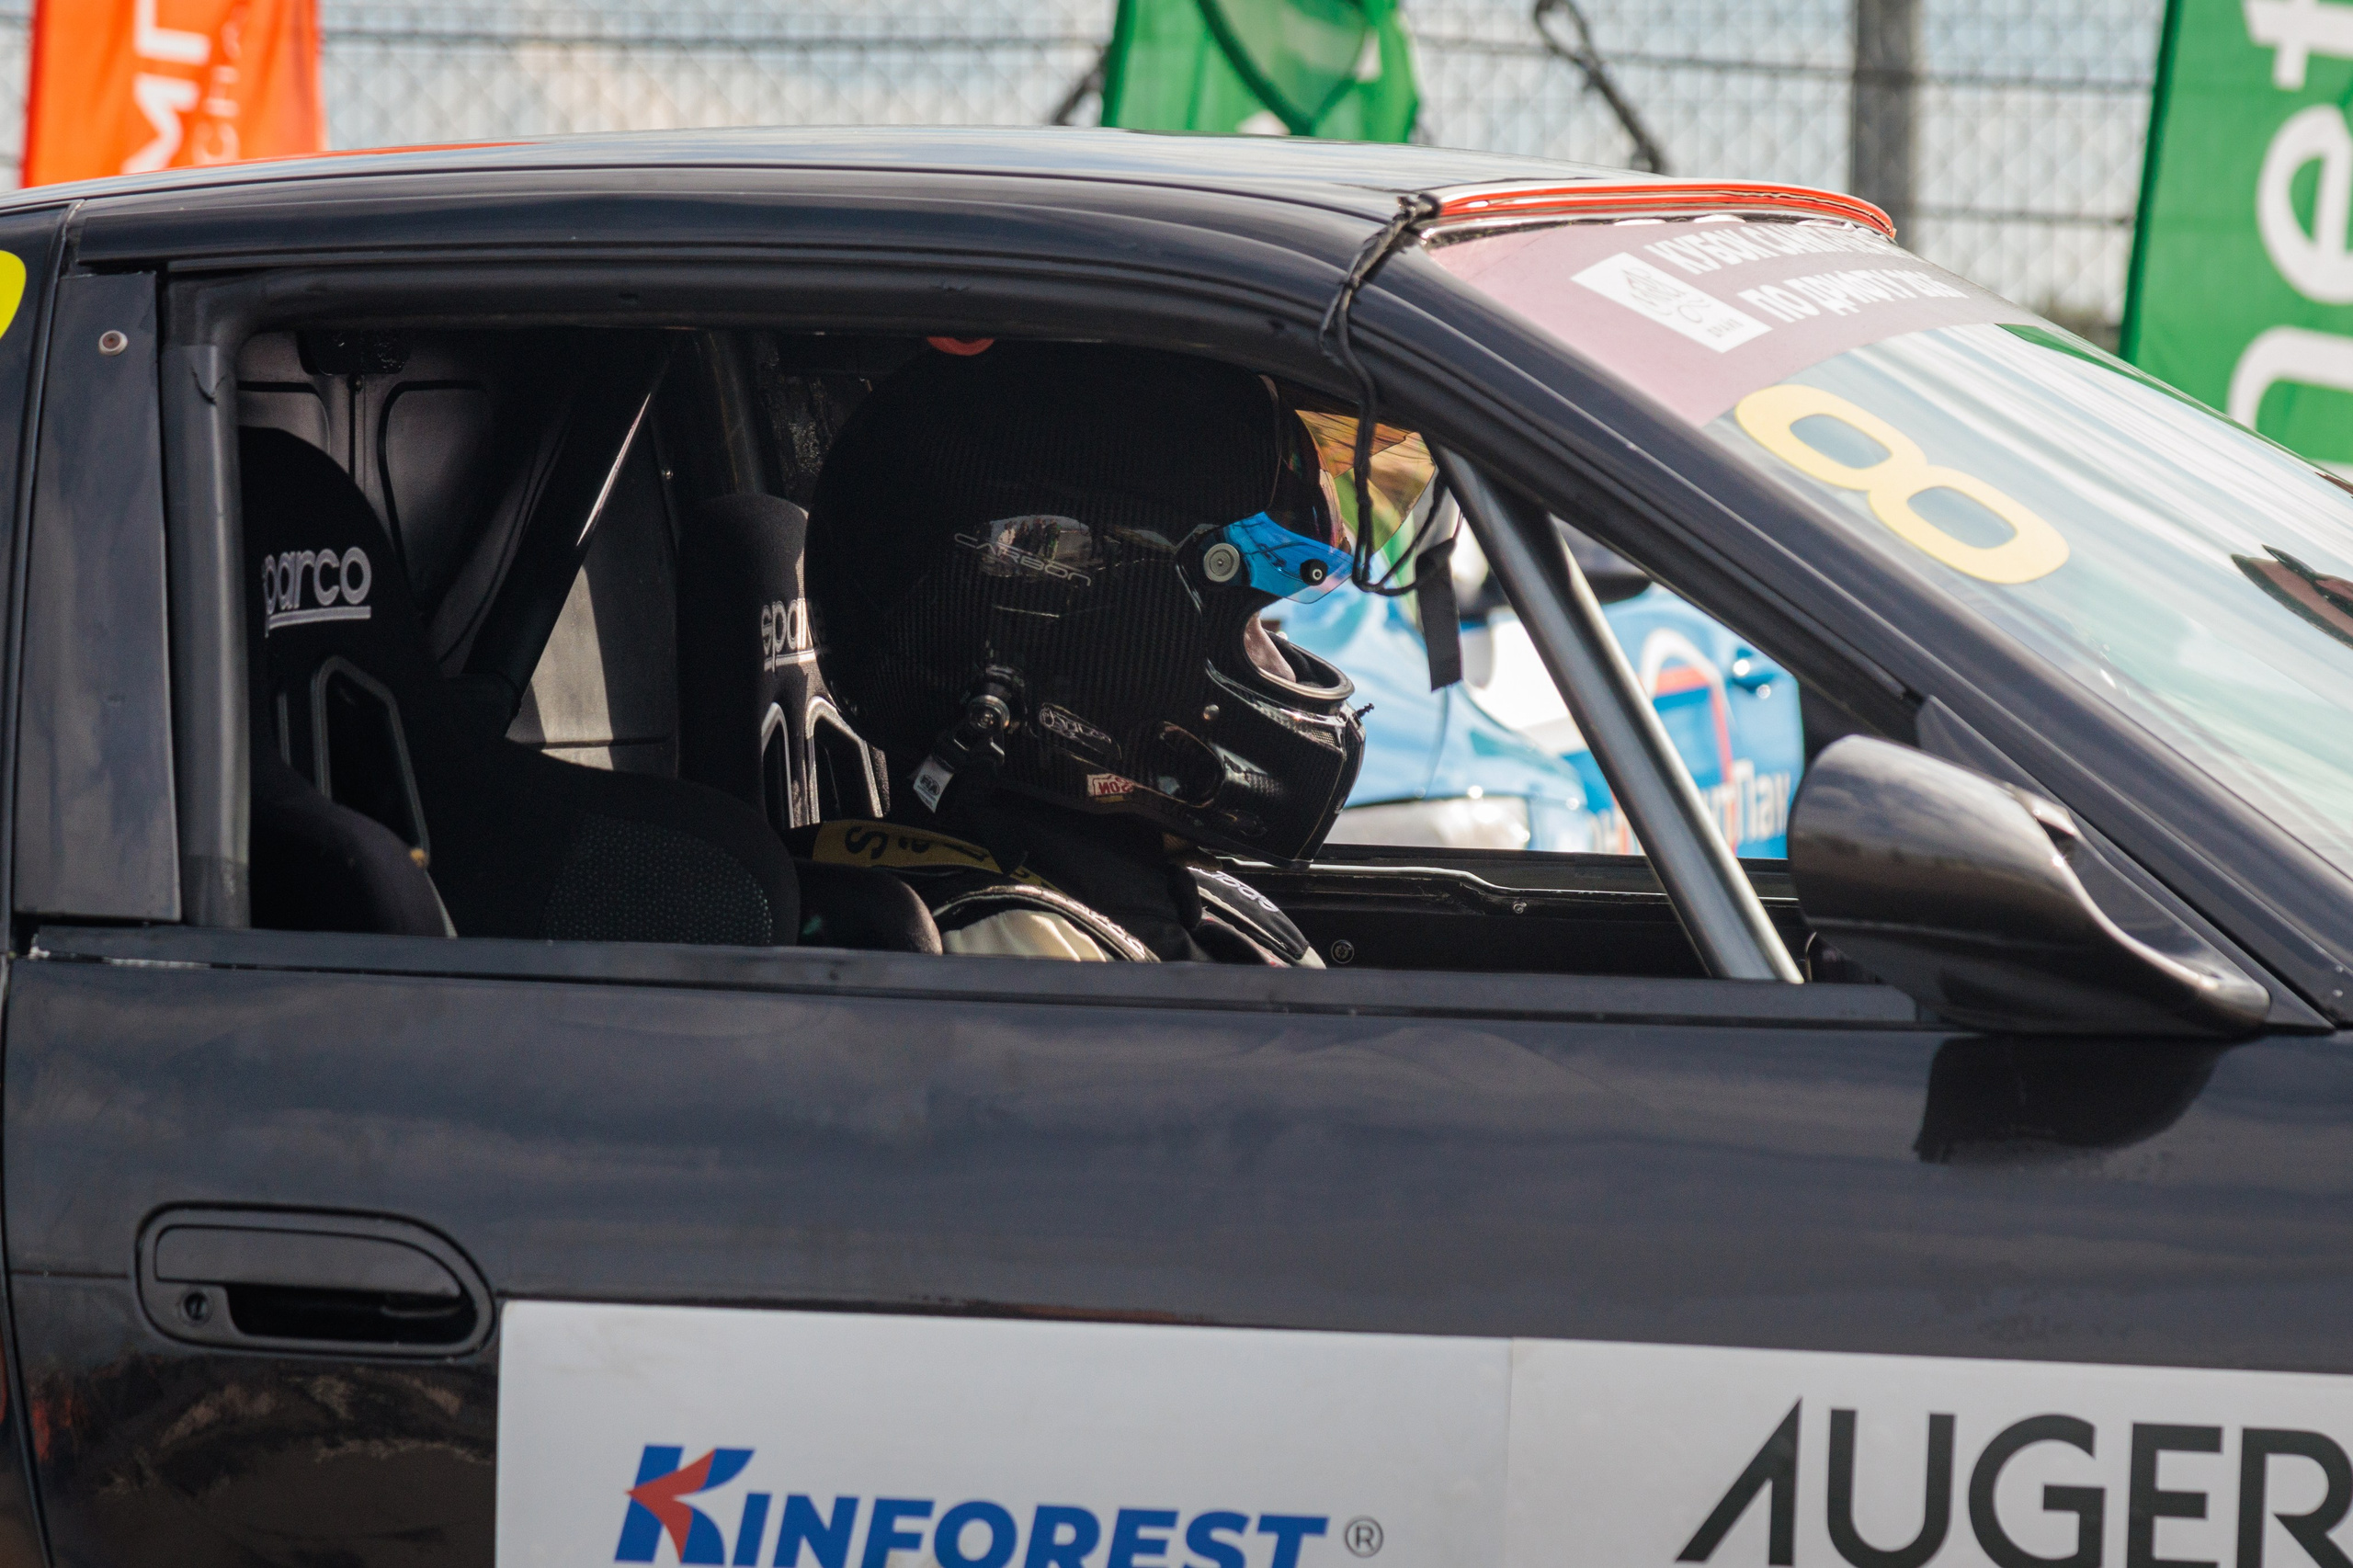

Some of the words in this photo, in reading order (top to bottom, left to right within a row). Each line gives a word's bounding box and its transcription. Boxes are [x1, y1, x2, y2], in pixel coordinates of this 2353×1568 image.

[1643, 226, 1780, 275] КУБОК
[1737, 284, 1821, 323] ПО
[1781, 268, 1918, 316] ДРИФТУ
[1734, 383, 2070, 585] 8
[261, 546, 372, 638] parco
[613, 1444, 1331, 1568] KINFOREST
[1674, 1394, 2353, 1568] AUGER
